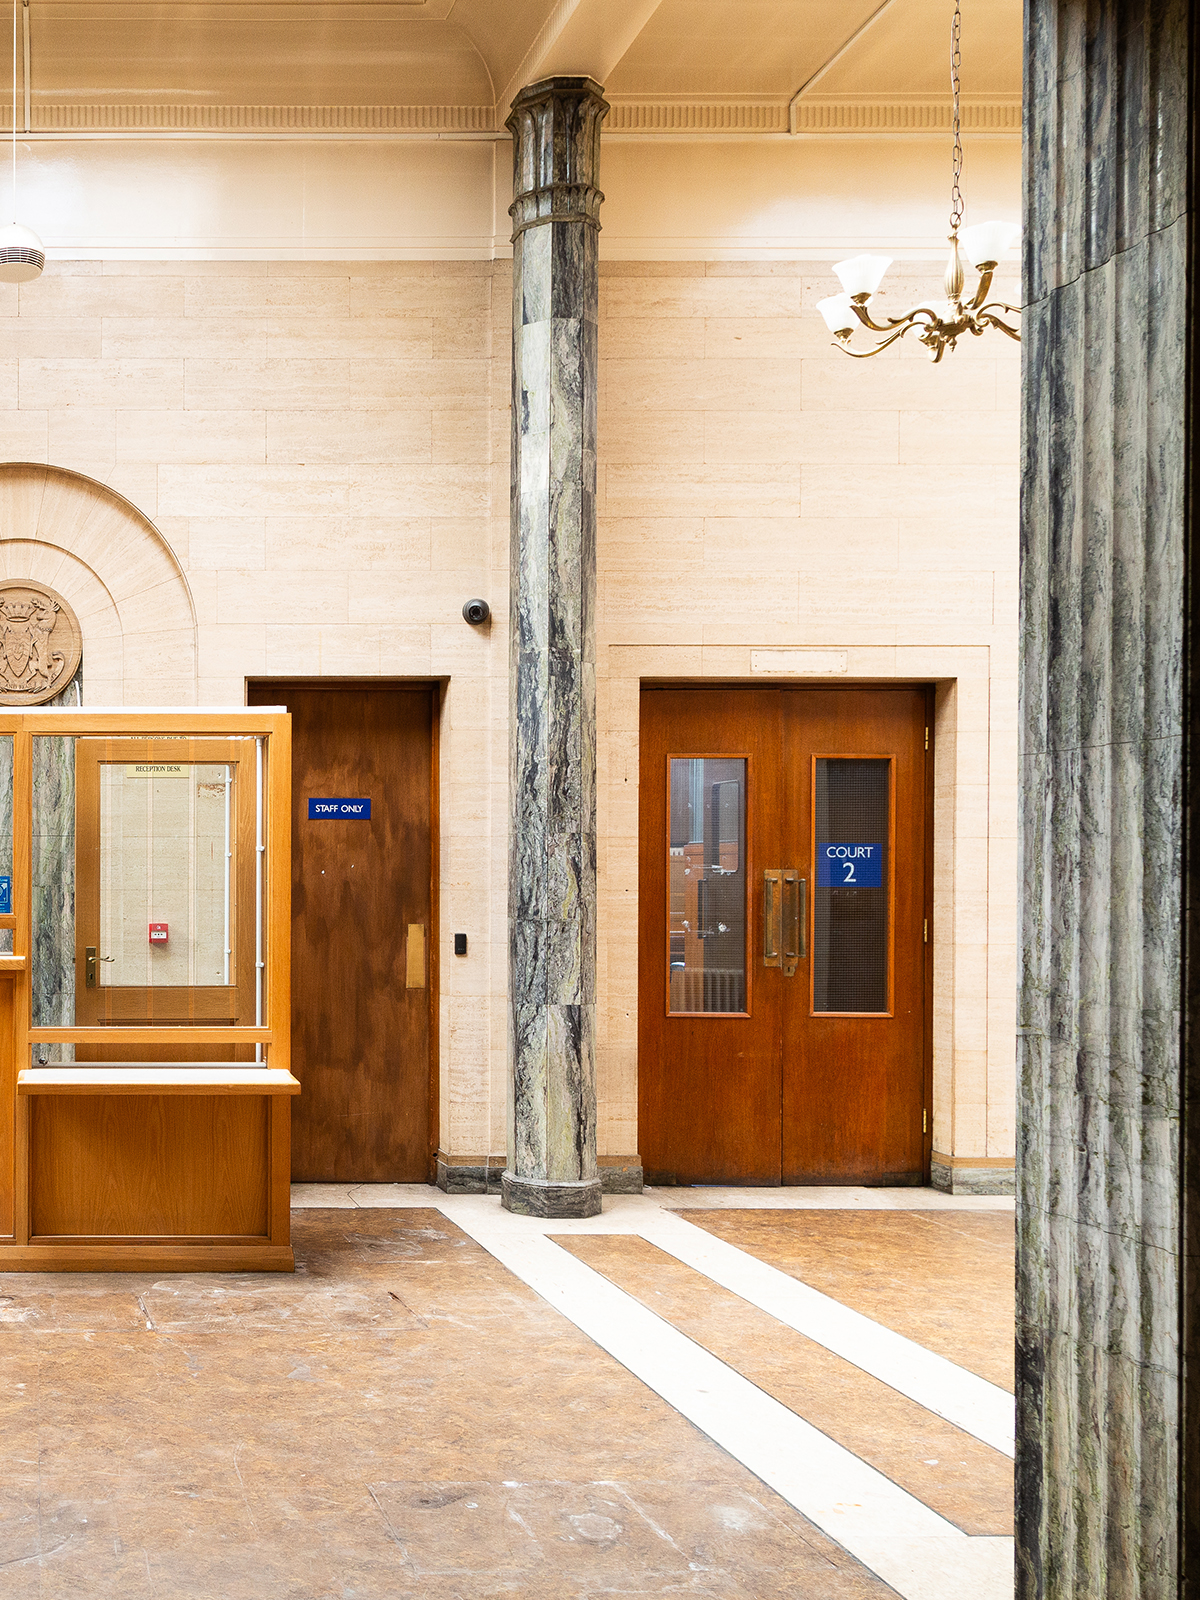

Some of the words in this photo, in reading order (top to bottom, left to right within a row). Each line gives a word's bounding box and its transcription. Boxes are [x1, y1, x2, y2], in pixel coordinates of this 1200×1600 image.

[315, 804, 339, 813] STAFF
[340, 804, 364, 813] ONLY
[826, 846, 874, 858] COURT
[842, 862, 857, 882] 2
